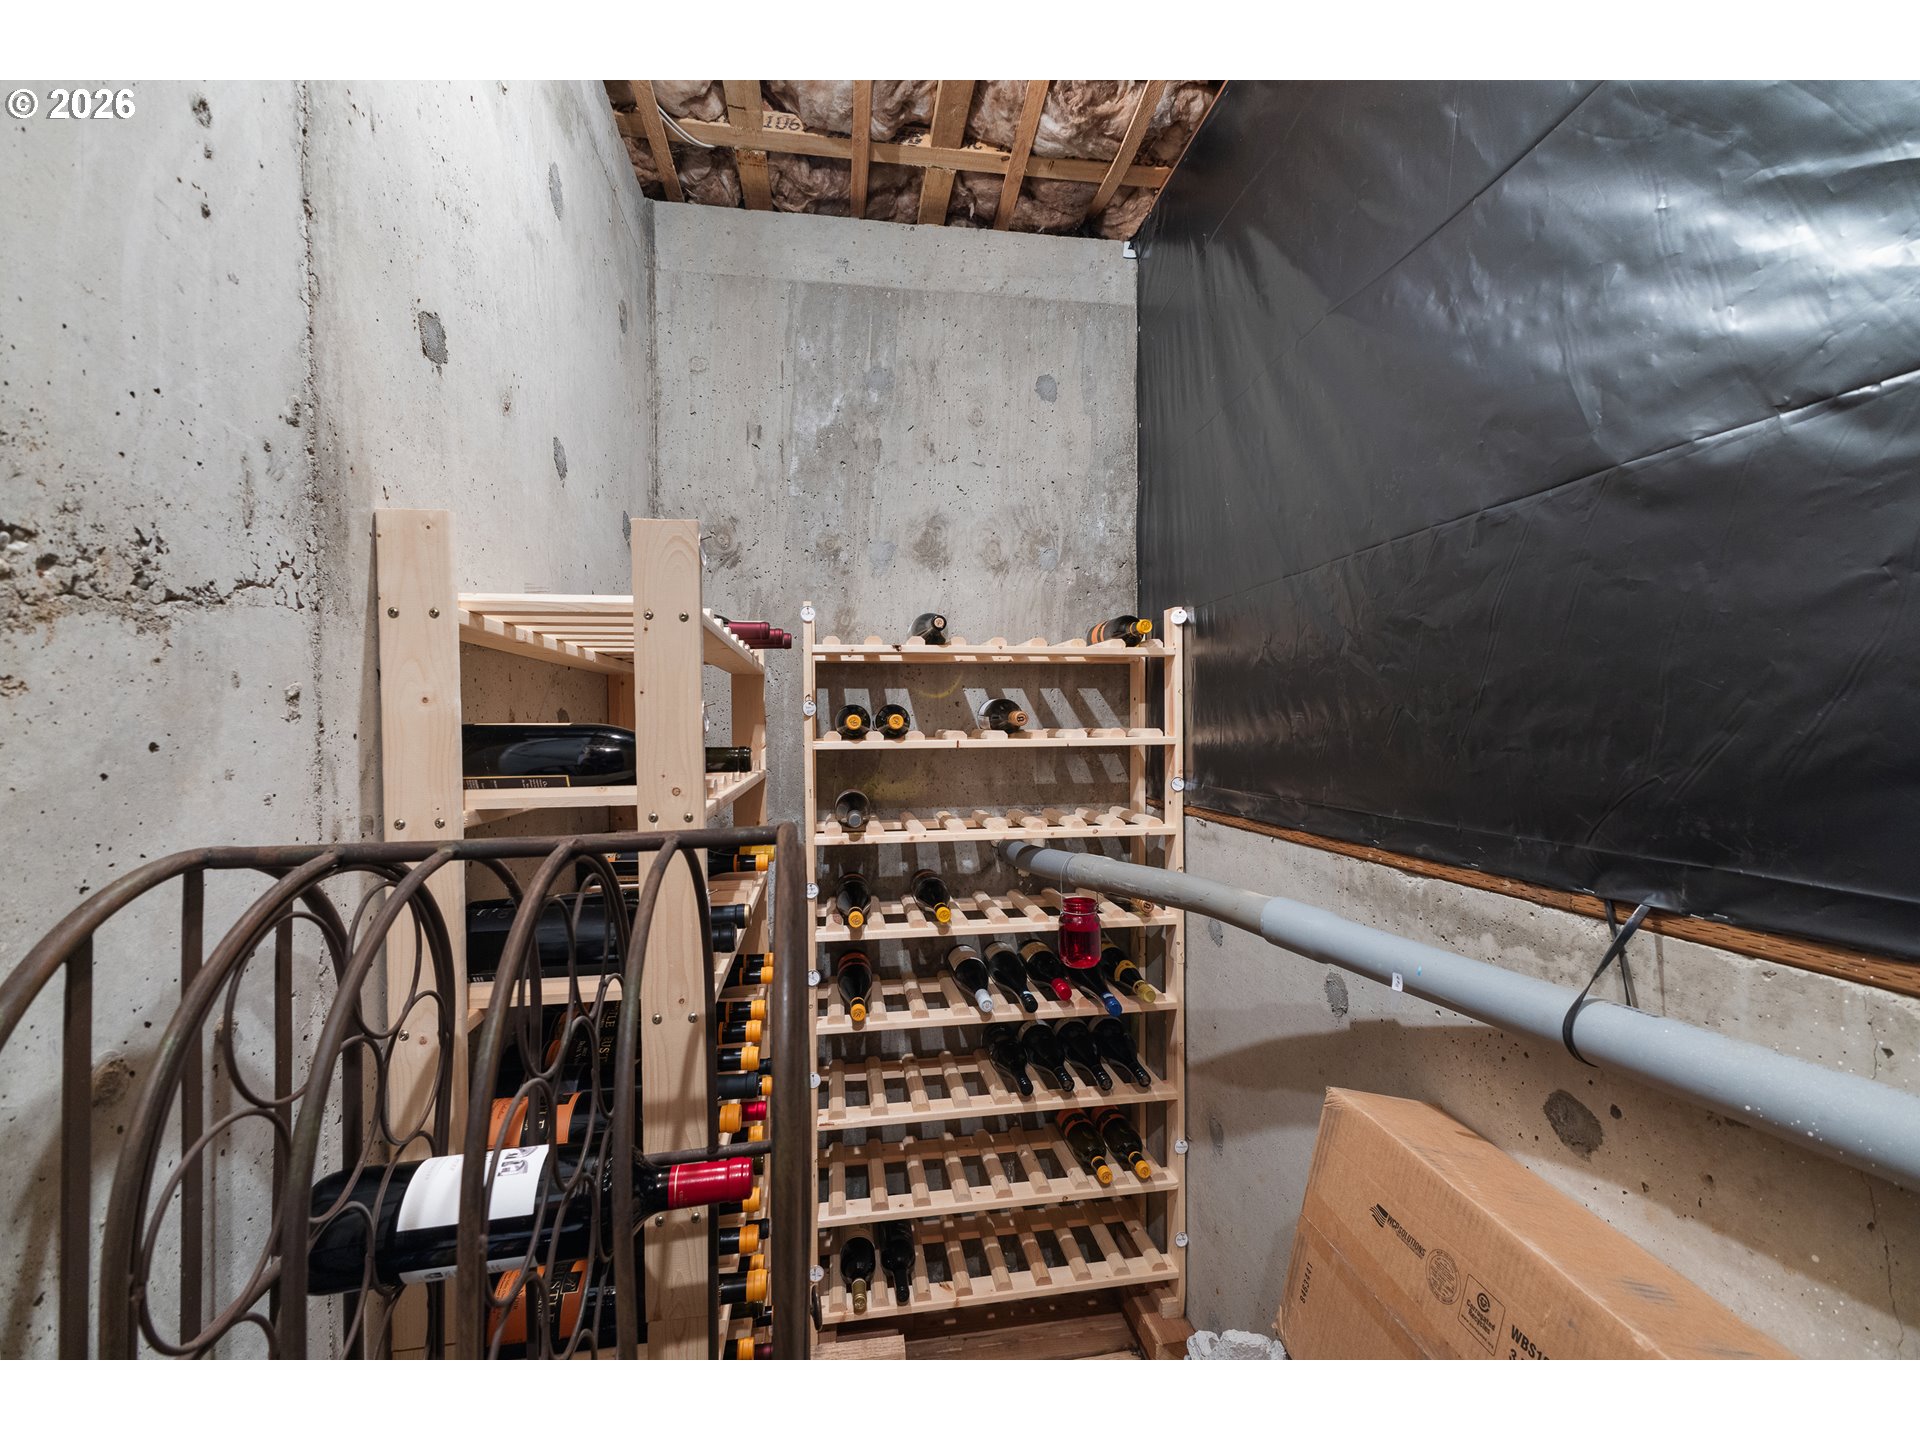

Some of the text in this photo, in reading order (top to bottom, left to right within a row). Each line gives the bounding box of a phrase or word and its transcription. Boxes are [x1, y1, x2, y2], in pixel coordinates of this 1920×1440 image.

[1398, 1226, 1426, 1257] SOLUTIONS
[1466, 1298, 1496, 1332] Corrugated
[1467, 1307, 1491, 1336] Recycles
[1511, 1324, 1550, 1360] WBS1
